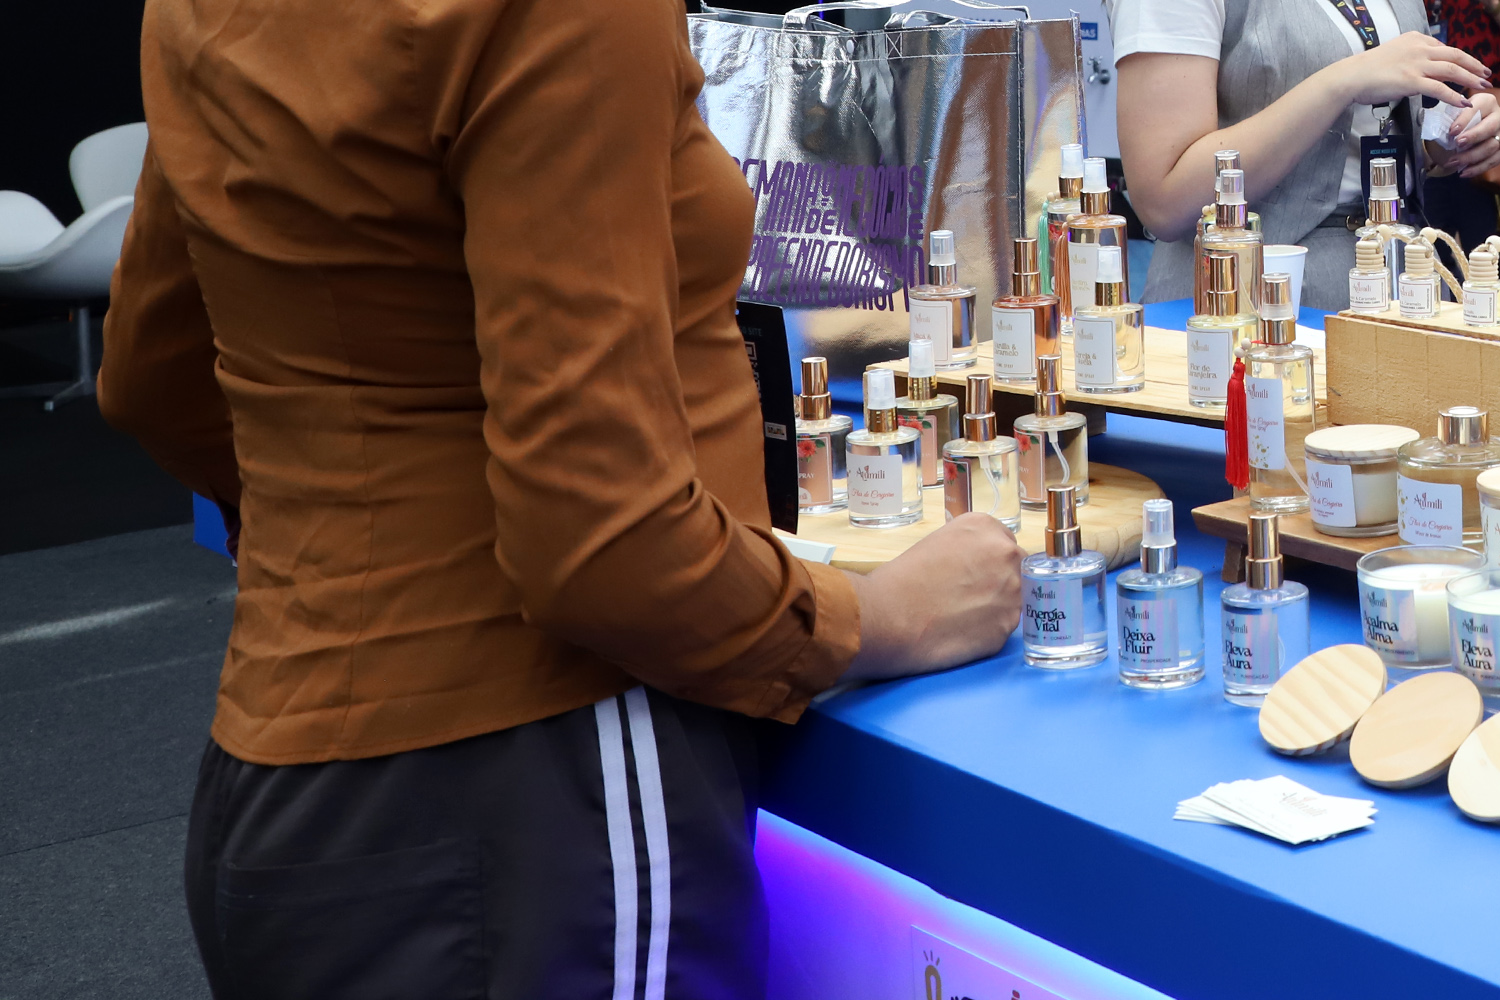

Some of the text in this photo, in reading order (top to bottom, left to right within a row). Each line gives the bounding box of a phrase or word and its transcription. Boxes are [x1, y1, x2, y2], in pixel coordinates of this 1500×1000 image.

[1034, 618, 1060, 632] Vital
[1123, 625, 1156, 642] Deixa
[1366, 626, 1394, 645] Alma
[1125, 639, 1153, 655] Fluir
[1225, 640, 1253, 657] Eleva
[1461, 639, 1493, 658] Eleva
[1226, 653, 1252, 670] Aura
[1463, 653, 1493, 671] Aura
